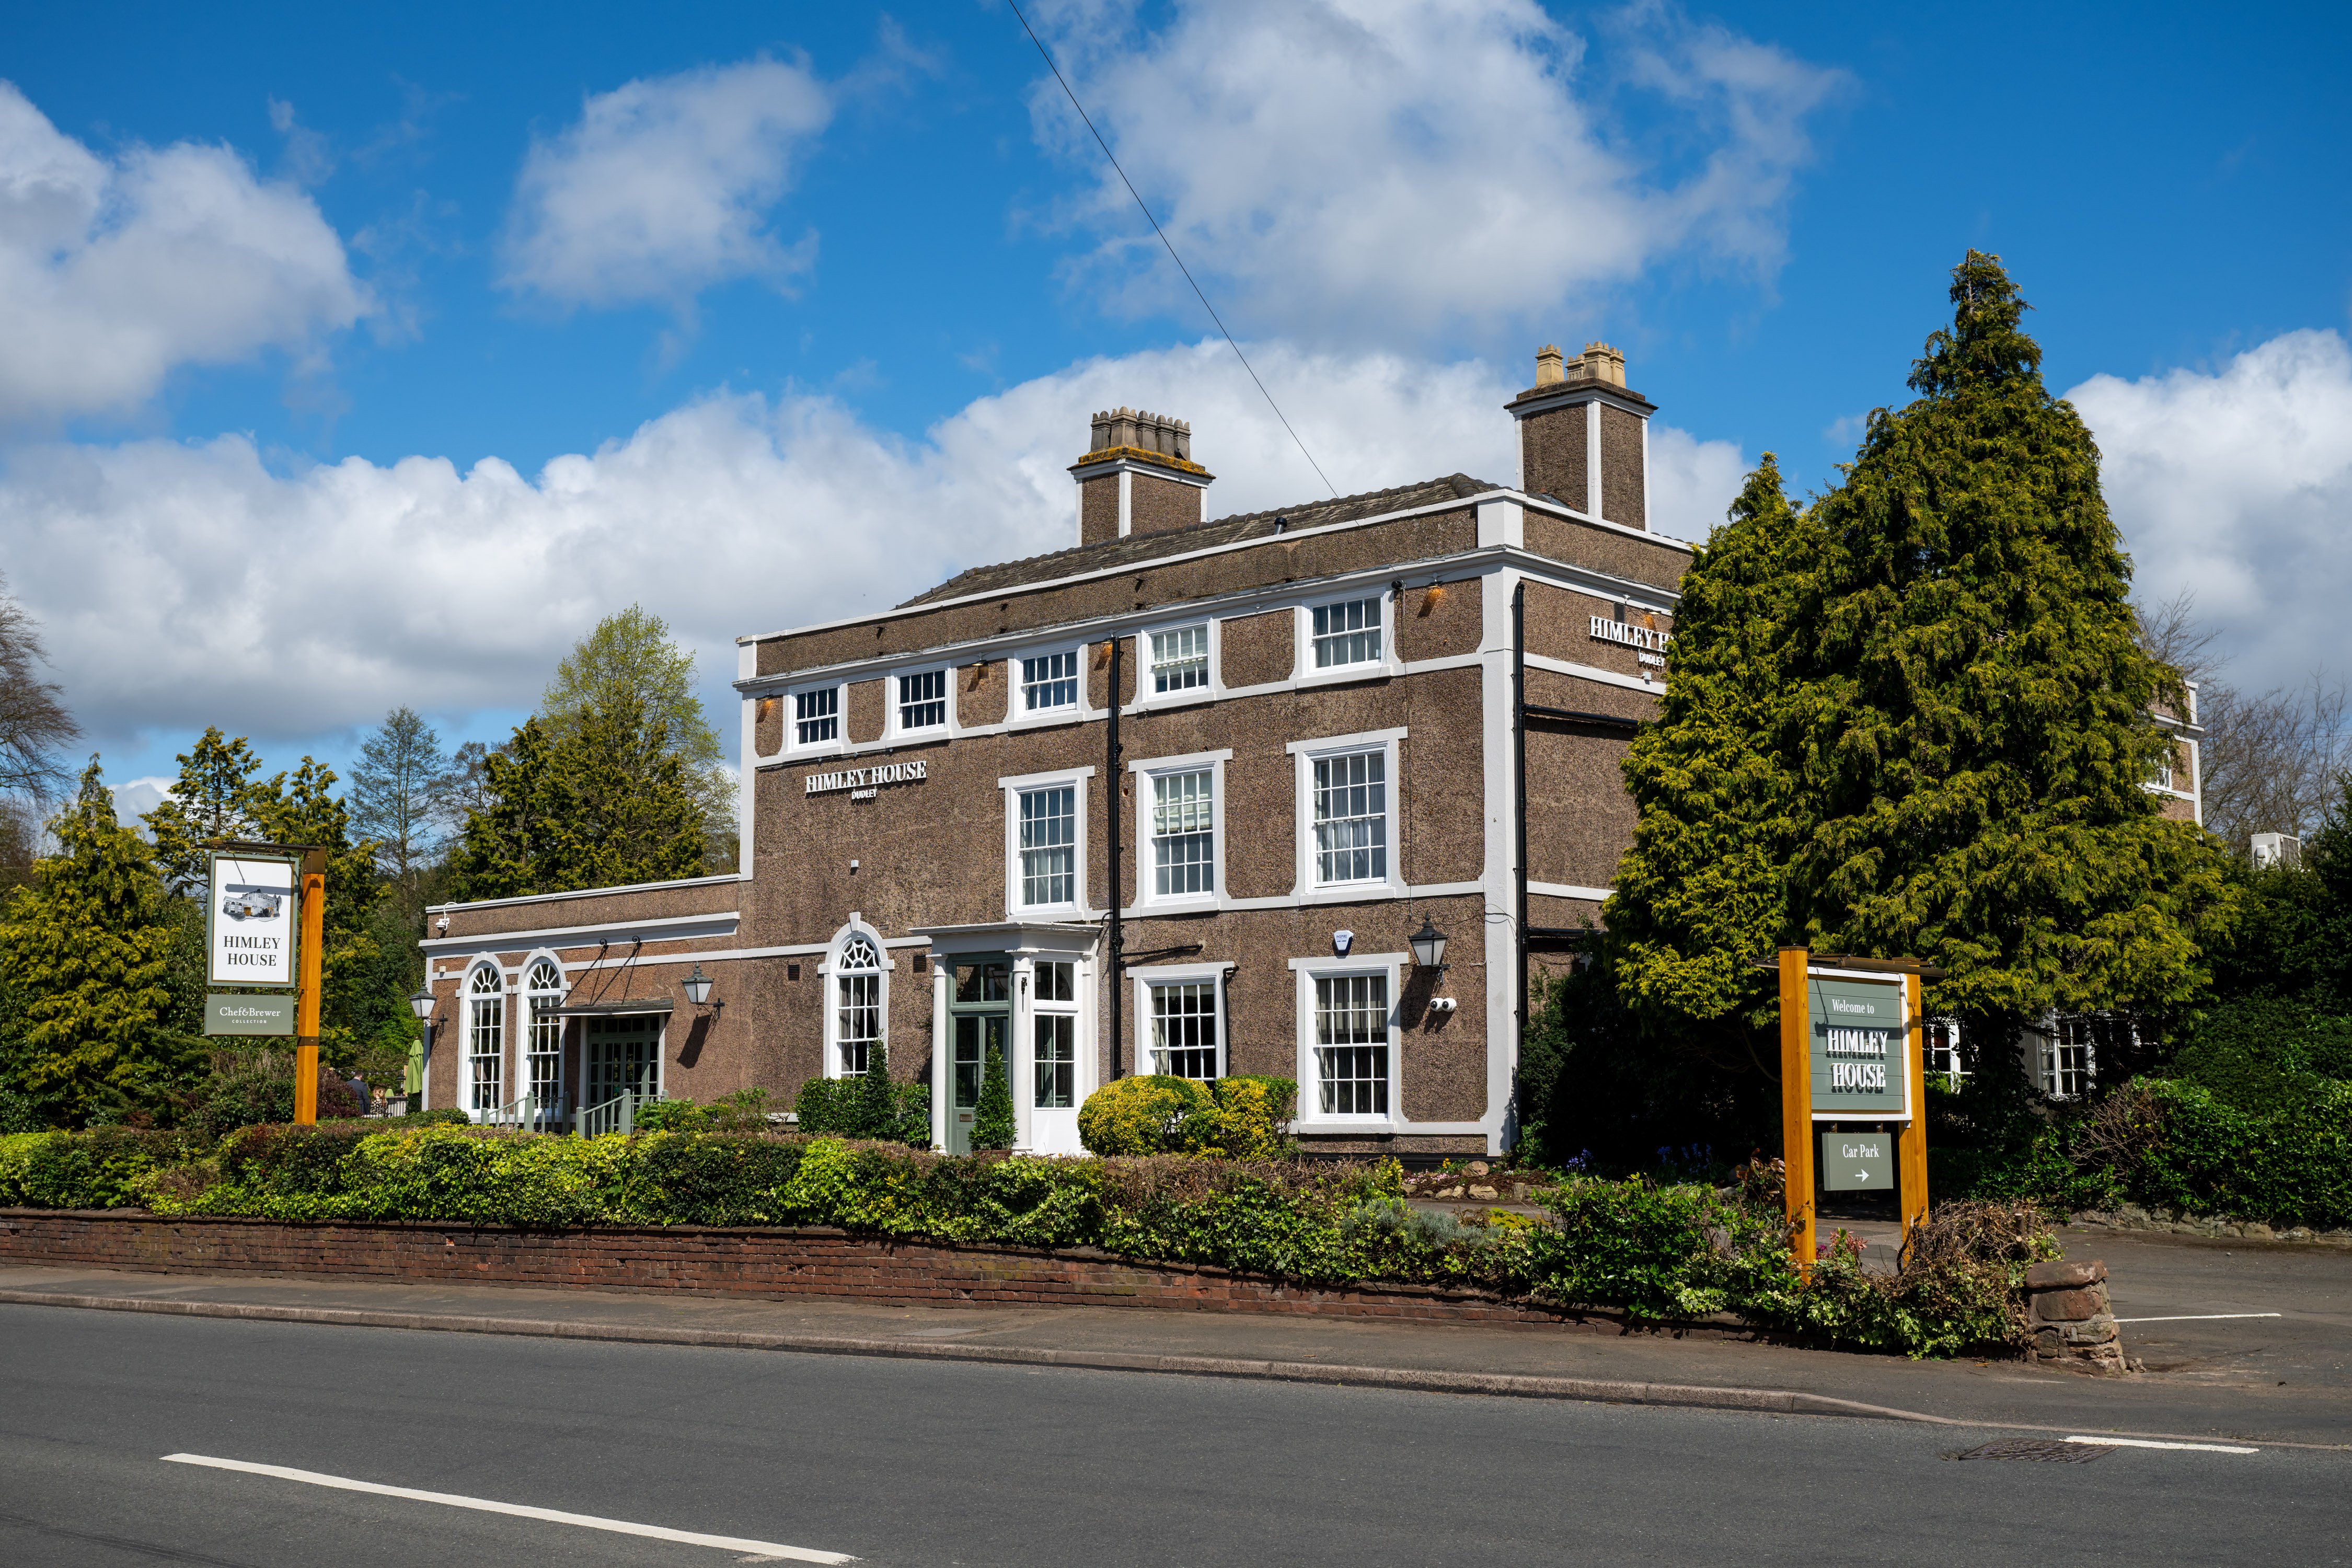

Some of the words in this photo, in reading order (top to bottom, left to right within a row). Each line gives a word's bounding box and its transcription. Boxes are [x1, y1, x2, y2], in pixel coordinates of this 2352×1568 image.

[1589, 615, 1654, 649] HIMLEY
[1639, 652, 1665, 667] DUDLEY
[805, 768, 868, 793] HIMLEY
[871, 760, 927, 785] HOUSE
[851, 788, 878, 800] DUDLEY
[223, 936, 281, 949] HIMLEY
[227, 953, 276, 966] HOUSE
[220, 1007, 281, 1017] Chef&Brewer
[1831, 999, 1865, 1013] Welcome
[1866, 1002, 1875, 1014] to
[1826, 1028, 1889, 1054] HIMLEY
[1831, 1063, 1886, 1087] HOUSE
[1842, 1144, 1858, 1158] Car
[1859, 1144, 1880, 1158] Park
